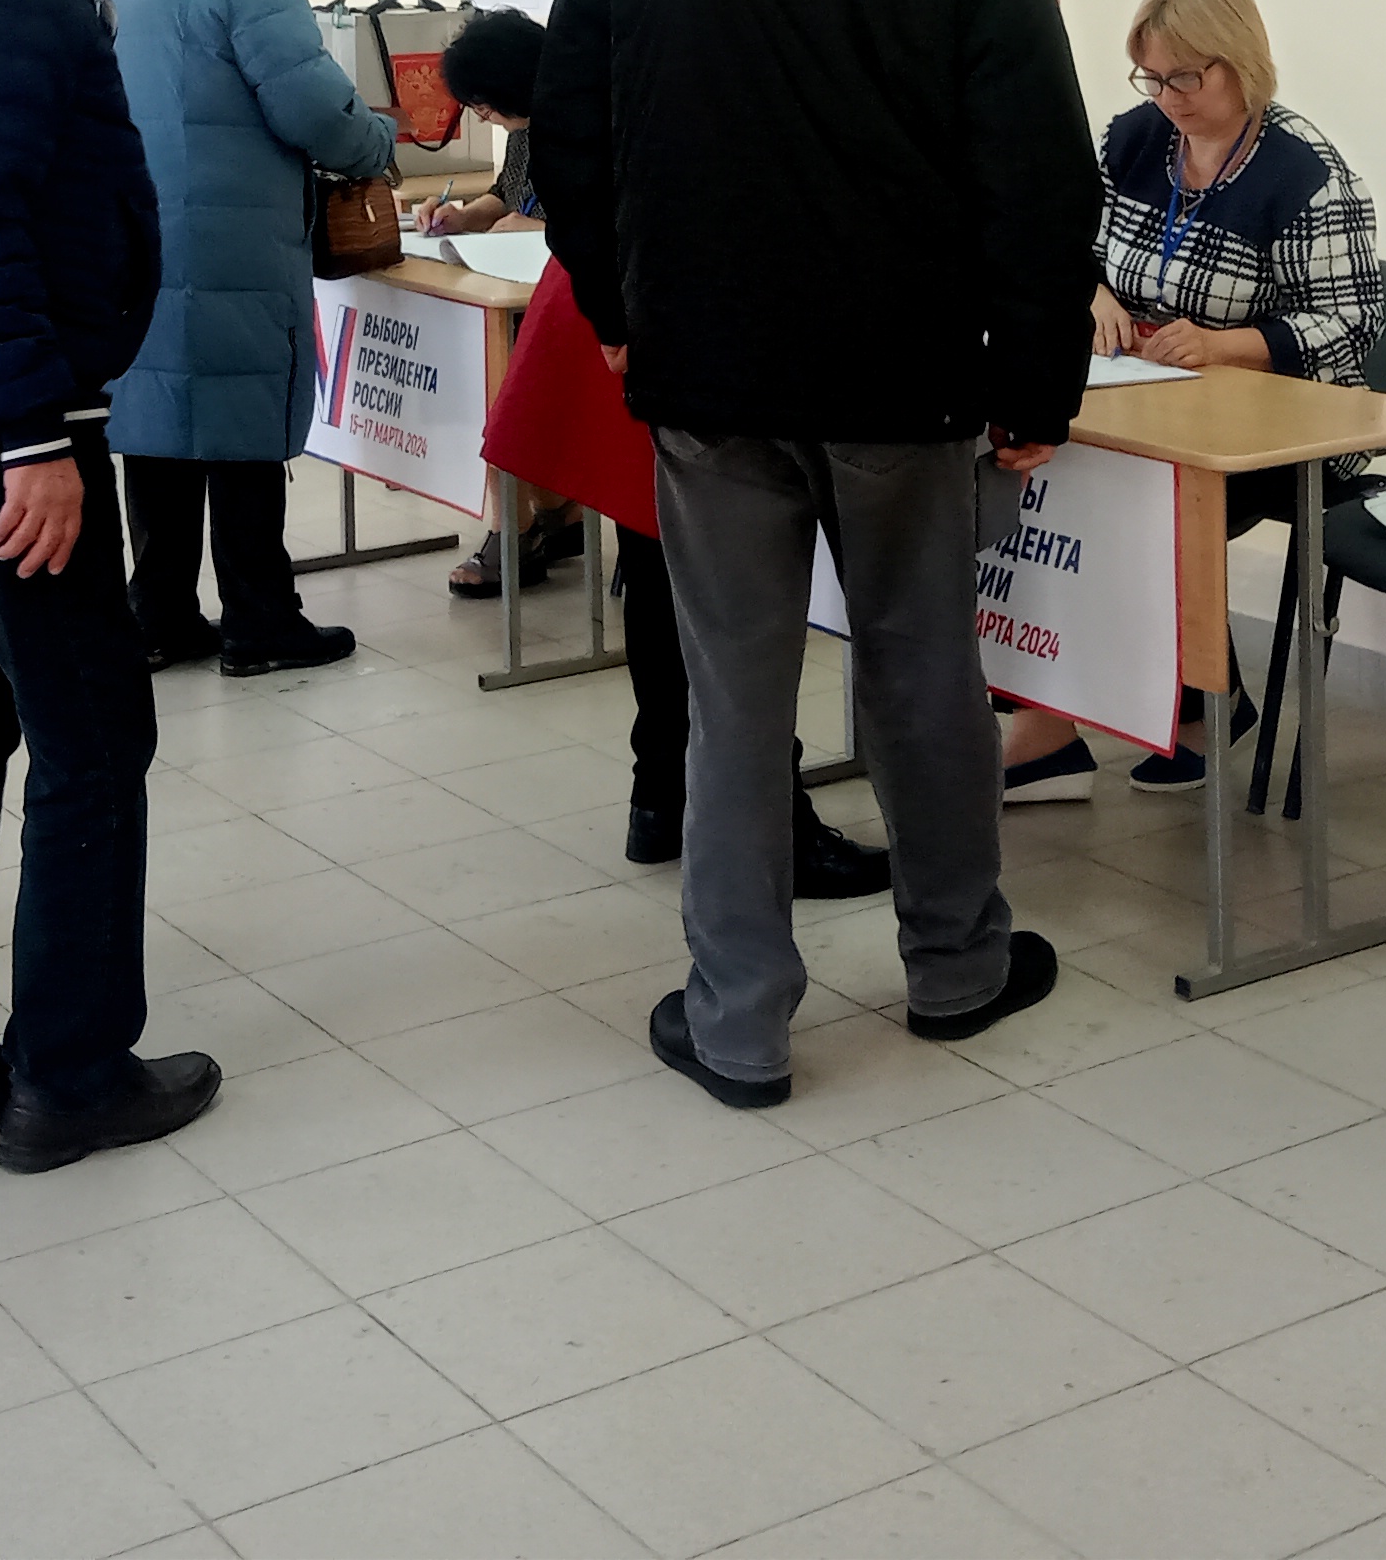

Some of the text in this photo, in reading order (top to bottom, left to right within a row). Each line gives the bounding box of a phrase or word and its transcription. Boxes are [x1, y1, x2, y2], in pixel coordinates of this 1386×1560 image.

[363, 312, 420, 351] ВЫБОРЫ
[357, 346, 438, 394] ПРЕЗИДЕНТА
[352, 381, 403, 419] РОССИИ
[374, 422, 403, 452] МАРТА
[404, 432, 428, 459] 2024
[1016, 621, 1060, 662] 2024
